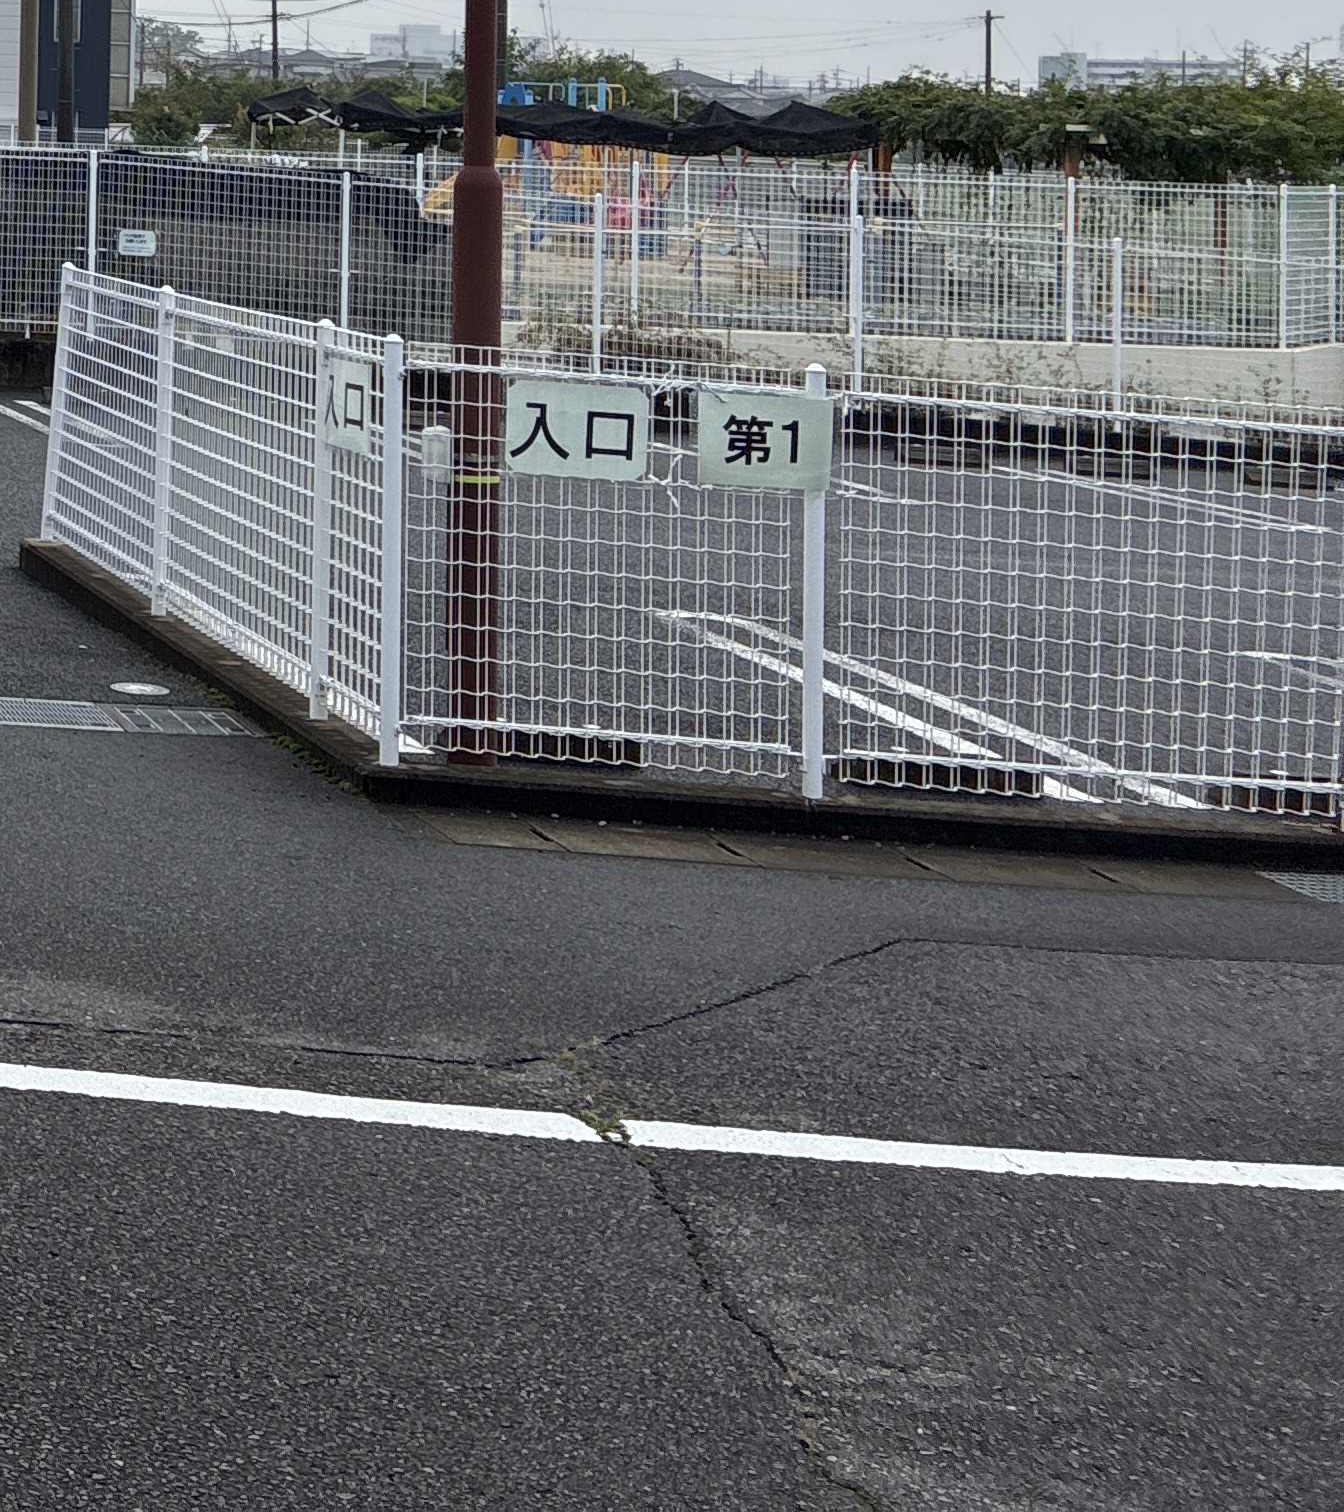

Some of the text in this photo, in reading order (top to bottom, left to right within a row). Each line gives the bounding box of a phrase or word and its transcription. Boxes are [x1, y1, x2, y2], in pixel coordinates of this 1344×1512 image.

[324, 374, 365, 432] 入口
[509, 401, 635, 461] 入口
[722, 414, 801, 466] 第1
